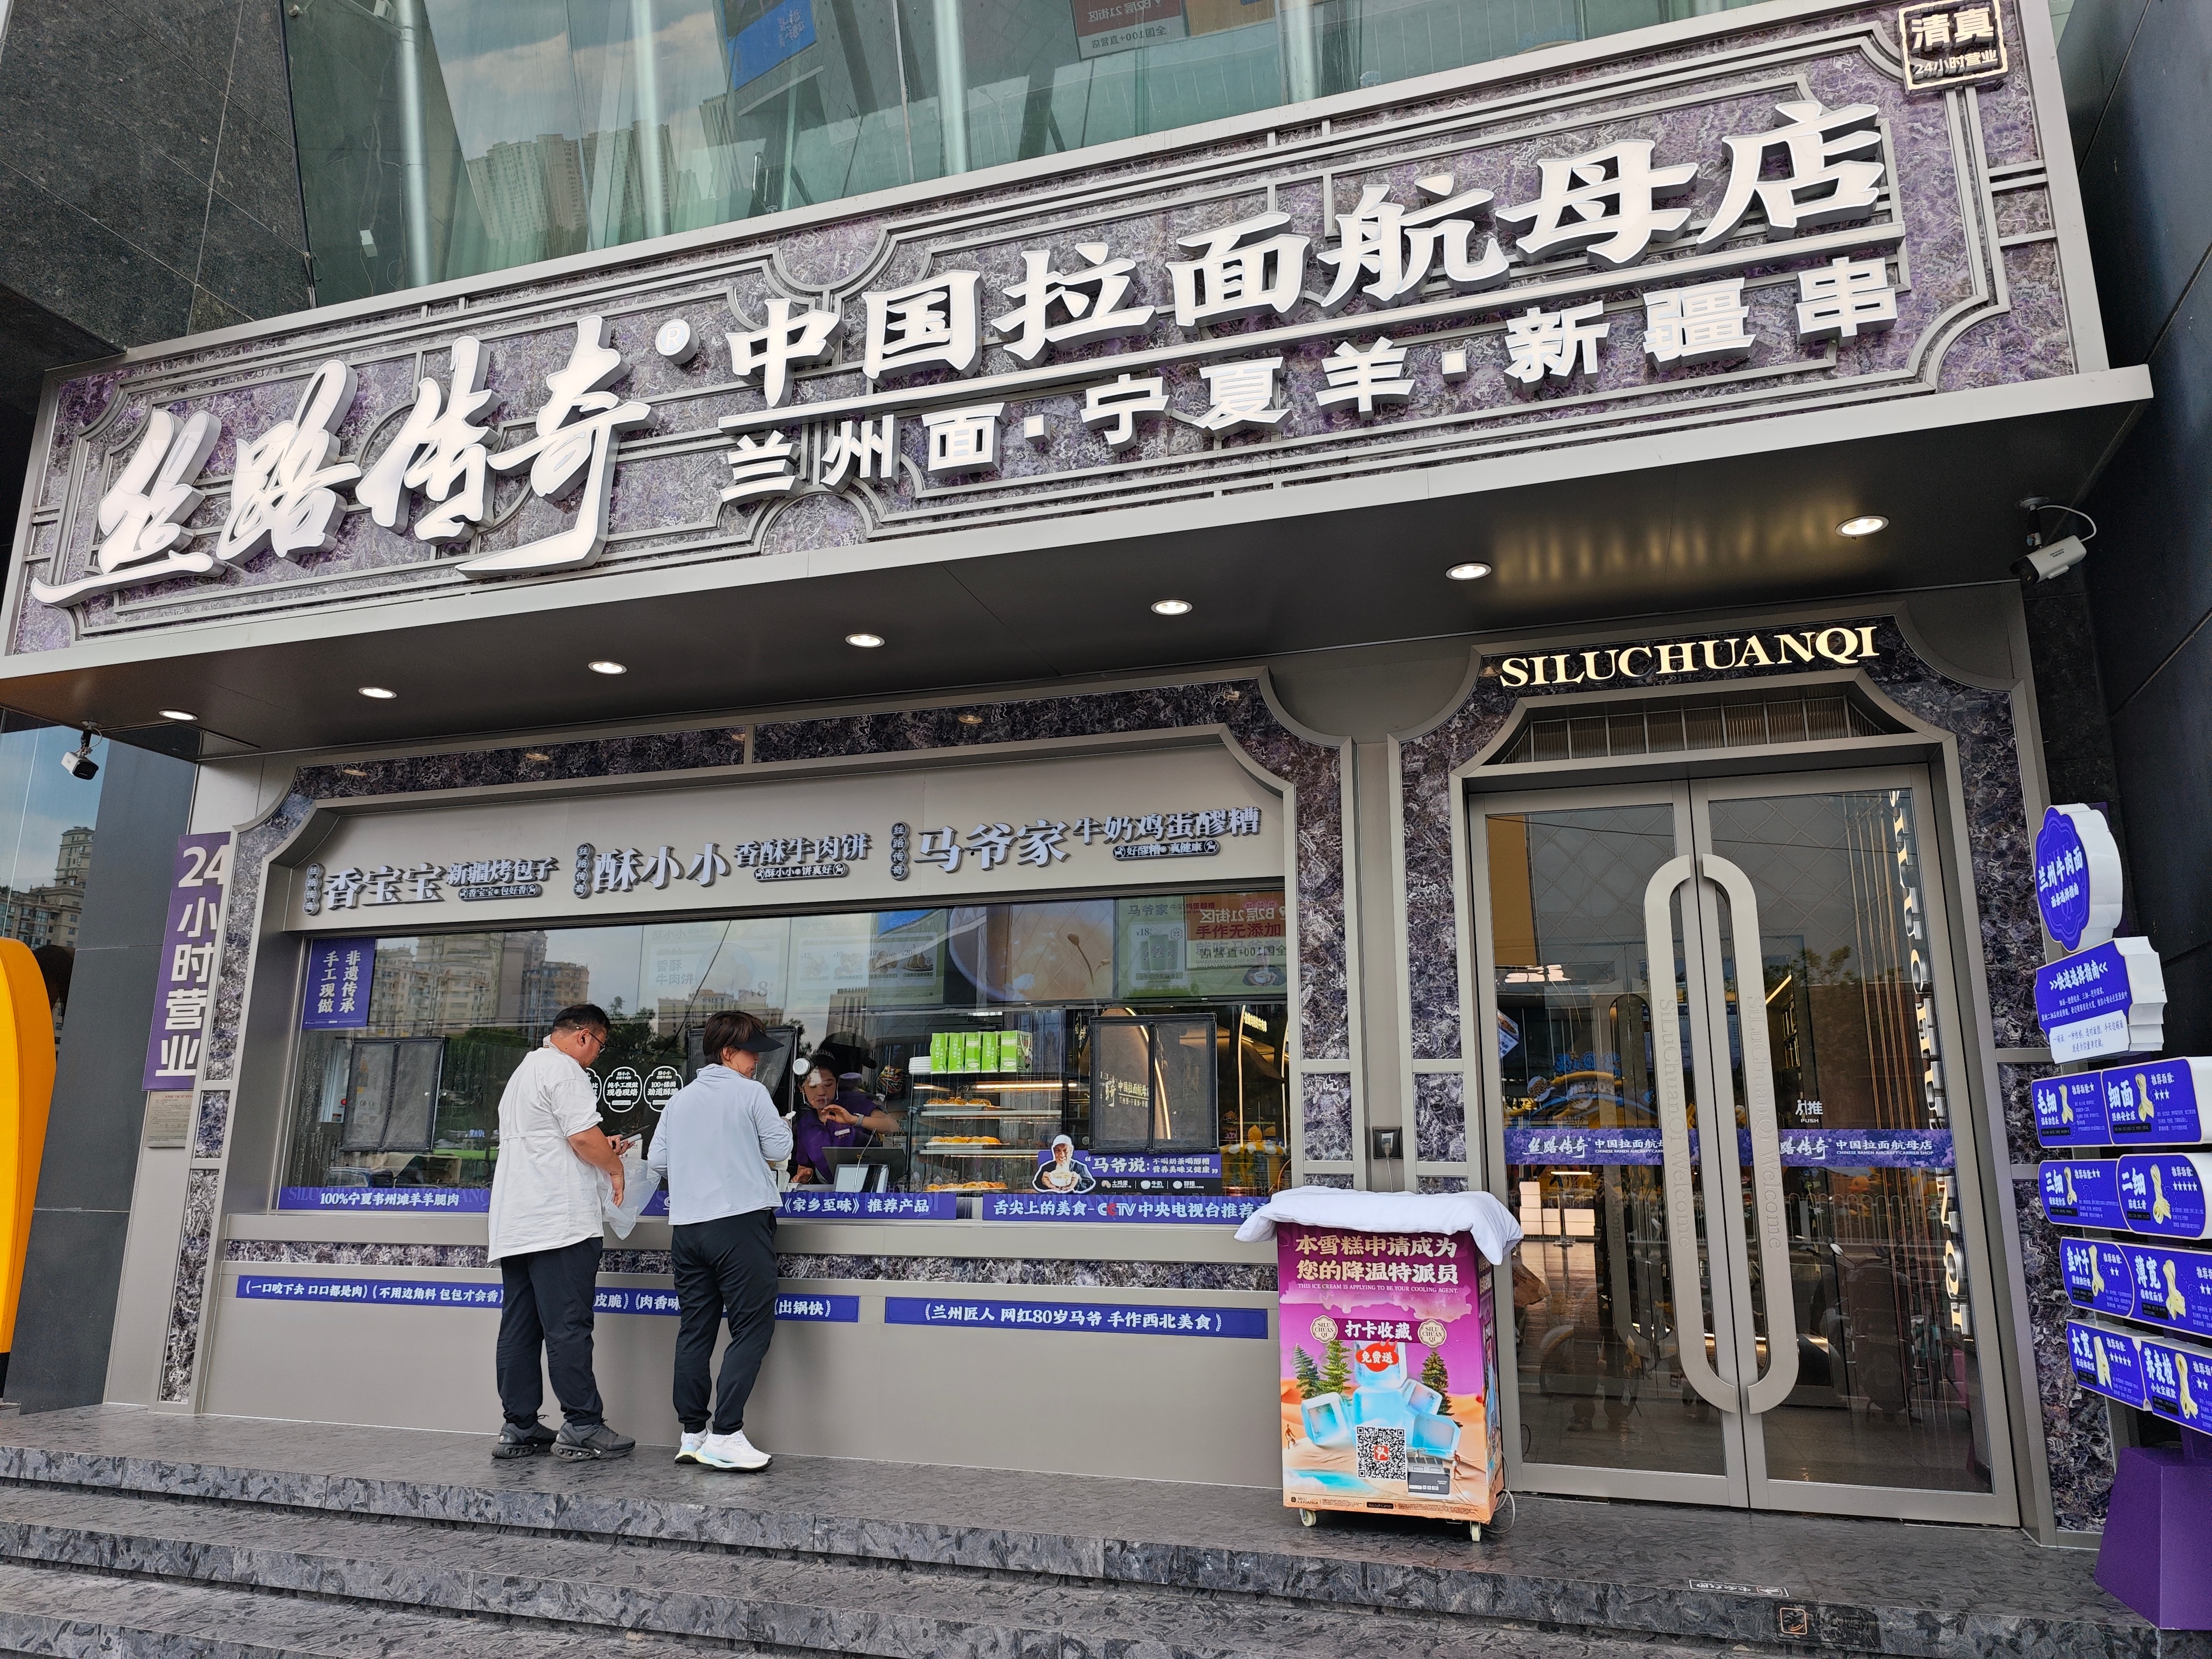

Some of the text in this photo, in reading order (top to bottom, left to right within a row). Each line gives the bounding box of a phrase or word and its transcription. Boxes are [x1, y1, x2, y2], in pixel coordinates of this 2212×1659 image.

[1911, 7, 1994, 50] 清真
[1914, 49, 1998, 75] 24小时营业
[725, 100, 1885, 408] 中国拉面航母店
[31, 314, 658, 608] 丝路传奇
[1499, 626, 1880, 687] SILUCHUANQI
[1073, 807, 1260, 845] 牛奶鸡蛋醪糟
[736, 833, 872, 867] 香酥牛肉饼
[892, 824, 905, 878] 丝路传奇
[914, 821, 1071, 873] 马爷家
[446, 858, 559, 886] 新疆烤包子
[575, 844, 589, 895] 丝路传奇
[595, 843, 731, 892] 酥小小
[765, 864, 832, 877] 酥小小 饼真好
[2038, 845, 2083, 893] 兰州牛肉面
[325, 864, 446, 909] 香宝宝
[1128, 903, 1169, 917] 马爷家
[1196, 922, 1281, 940] 手作无添加
[155, 845, 226, 1077] 24小时营业
[657, 959, 682, 972] 香酥
[318, 950, 340, 1014] 手工现做
[339, 949, 361, 1014] 非遗传承
[655, 972, 694, 986] 牛肉饼
[2037, 1088, 2058, 1115] 毛细
[2107, 1079, 2134, 1109] 细面
[1521, 1136, 1589, 1158] 丝路传奇
[1836, 1139, 1933, 1150] 中国拉面航母店
[2046, 1169, 2065, 1195] 三细
[2121, 1167, 2147, 1196] 二细
[320, 1192, 460, 1207] 100%宁夏韦州滩羊羊腿肉
[784, 1197, 929, 1214] 《家乡至味》 推荐产品
[1295, 1234, 1458, 1258] 本雪糕申请成为
[1296, 1259, 1459, 1285] 您的降温特派员
[2066, 1245, 2090, 1276] 韭叶子
[2134, 1255, 2161, 1289] 薄宽
[2196, 1266, 2212, 1281] 推荐指
[251, 1282, 498, 1303] 一口咬下去 口口都是肉 不用边角料 包包才会香
[778, 1300, 824, 1316] 出锅快
[931, 1305, 1212, 1331] 兰州匠人 网红80岁马爷 手作西北美食
[1344, 1321, 1412, 1340] 打卡收藏
[2072, 1328, 2093, 1360] 大宽
[1361, 1351, 1394, 1364] 免费送
